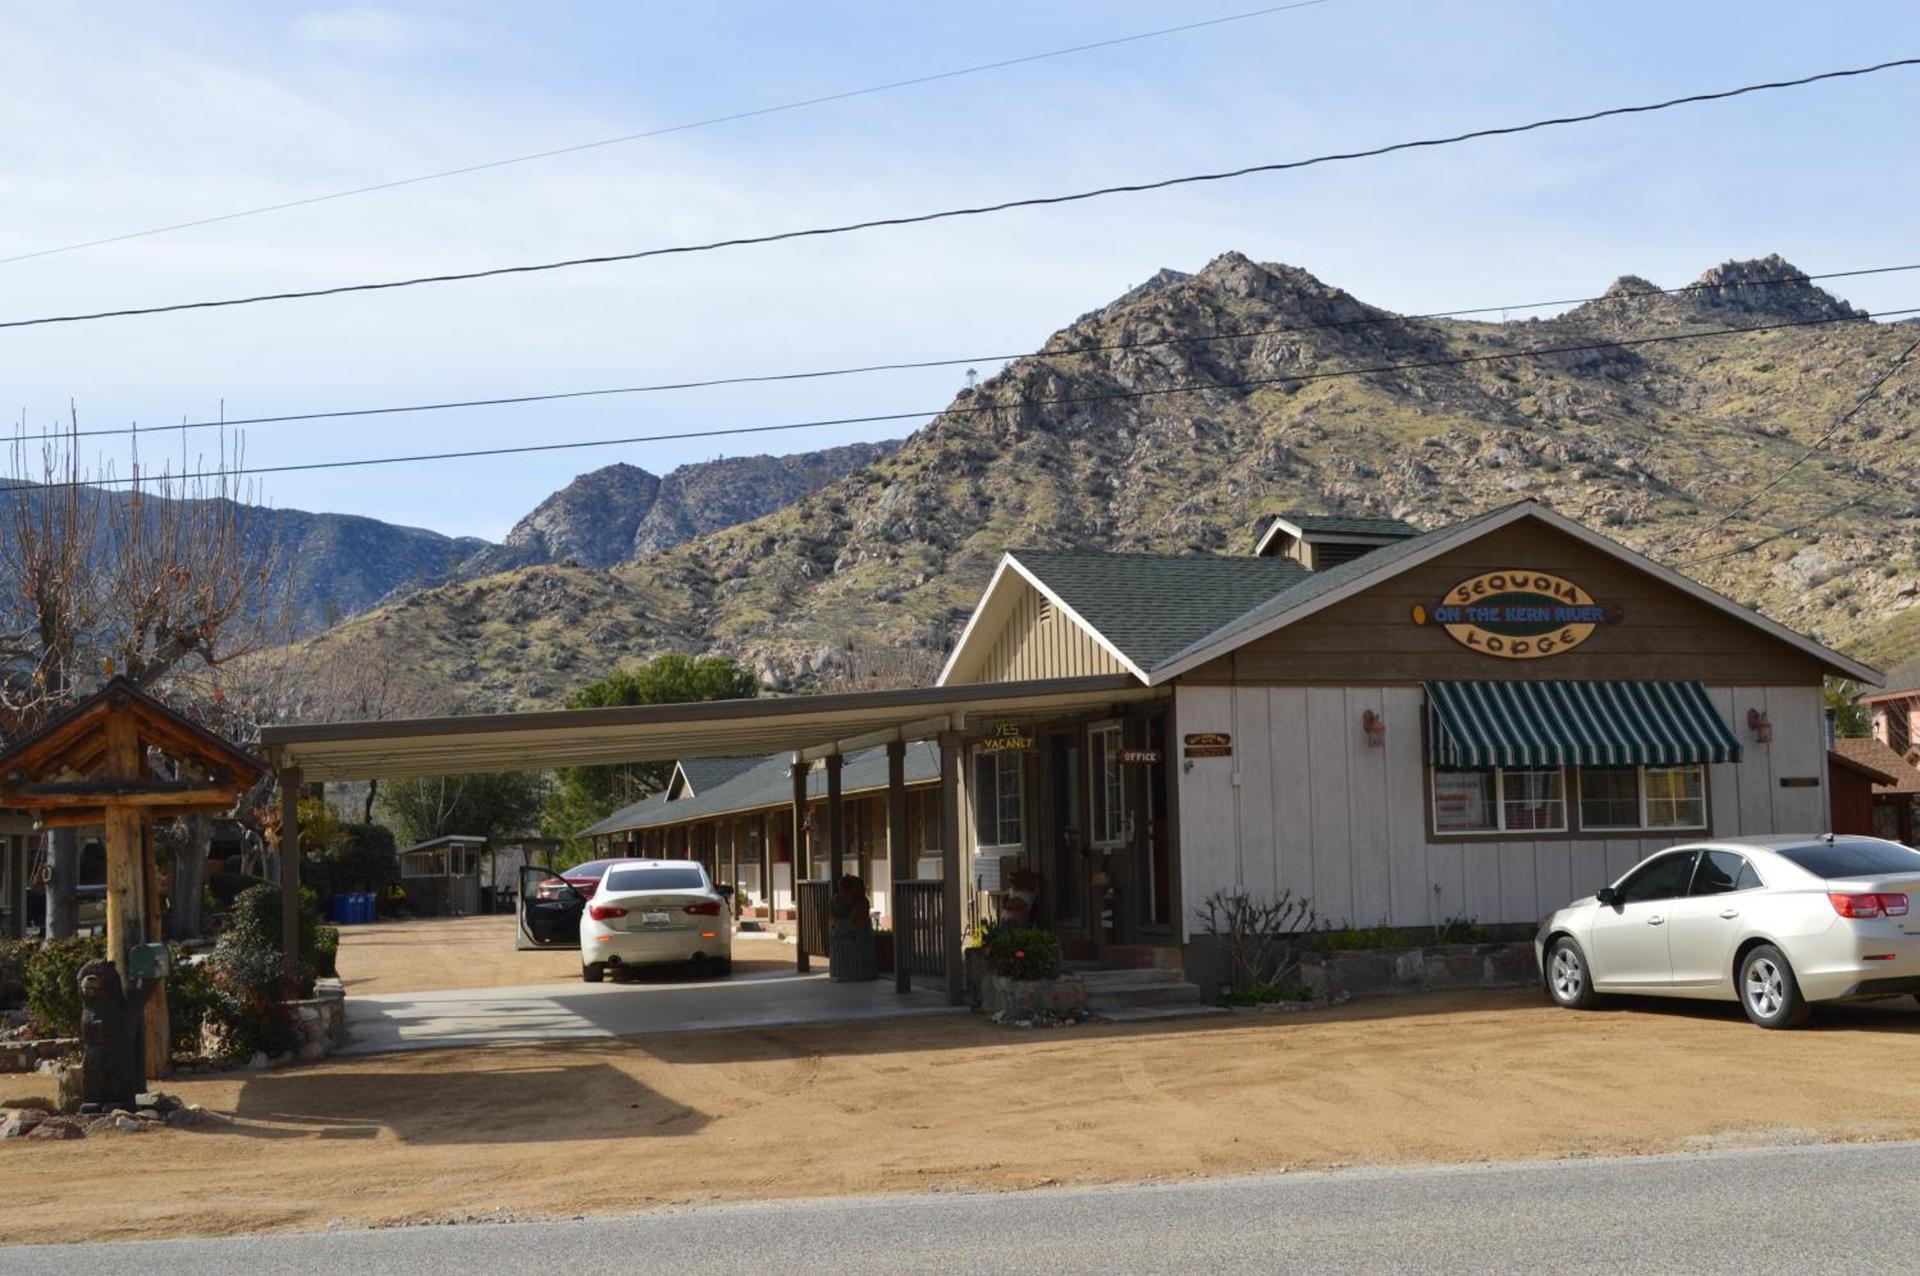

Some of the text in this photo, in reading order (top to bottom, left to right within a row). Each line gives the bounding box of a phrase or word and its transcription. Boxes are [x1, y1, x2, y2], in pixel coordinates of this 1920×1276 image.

[1456, 574, 1578, 603] SEQUOIA
[1435, 606, 1605, 623] ON THE KERN RIVER
[1466, 629, 1576, 655] LODGE
[995, 722, 1019, 736] YES
[984, 737, 1033, 749] VACANCY
[1124, 751, 1156, 762] OFFICE
